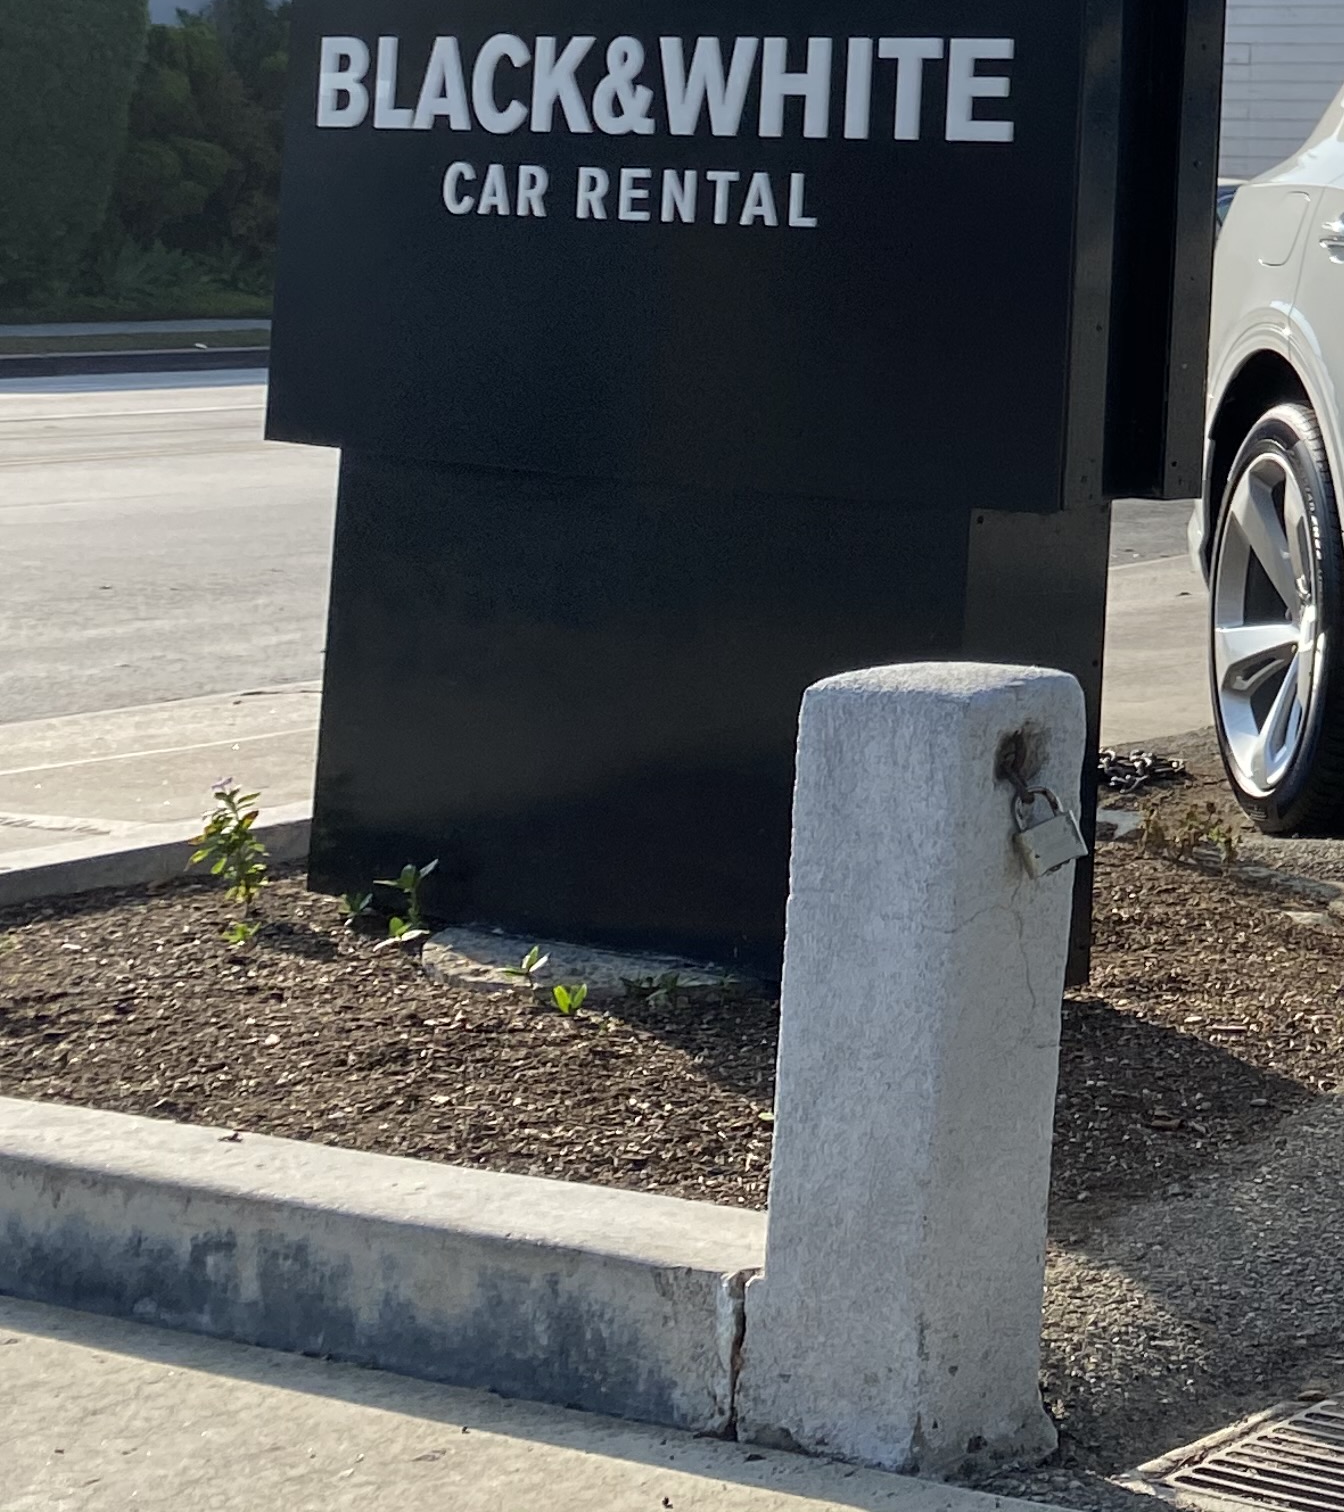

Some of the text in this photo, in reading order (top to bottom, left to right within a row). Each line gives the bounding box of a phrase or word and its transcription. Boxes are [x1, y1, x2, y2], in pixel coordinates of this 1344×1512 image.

[316, 33, 1015, 142] BLACK&WHITE
[442, 160, 818, 228] CAR RENTAL
